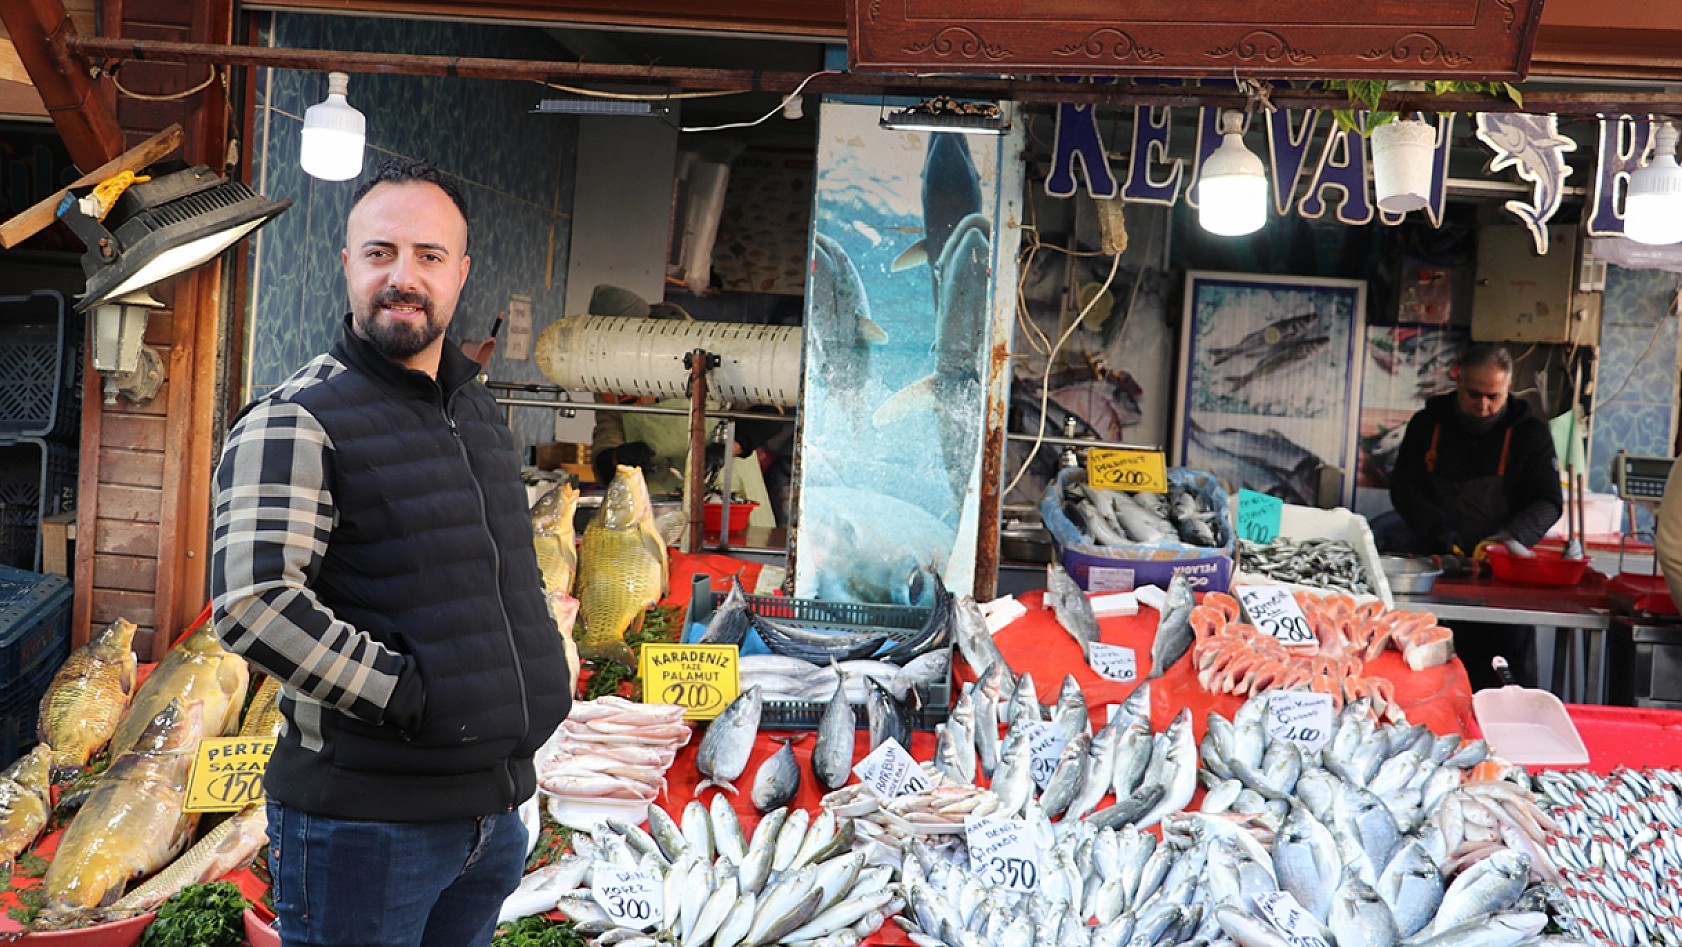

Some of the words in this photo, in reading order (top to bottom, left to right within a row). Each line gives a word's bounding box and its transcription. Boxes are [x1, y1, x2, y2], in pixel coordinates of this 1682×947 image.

[1045, 76, 1456, 229] KEVA
[1112, 469, 1144, 485] 200
[1260, 616, 1313, 642] 280
[652, 651, 730, 668] KARADENİZ
[681, 663, 702, 671] TAZE
[662, 671, 720, 681] PALAMUT
[671, 684, 708, 708] 200
[1283, 726, 1320, 741] 400
[208, 743, 274, 761] PERTE
[1031, 757, 1060, 784] 35
[221, 772, 264, 803] 150
[990, 856, 1037, 889] 350
[608, 895, 650, 920] 300
